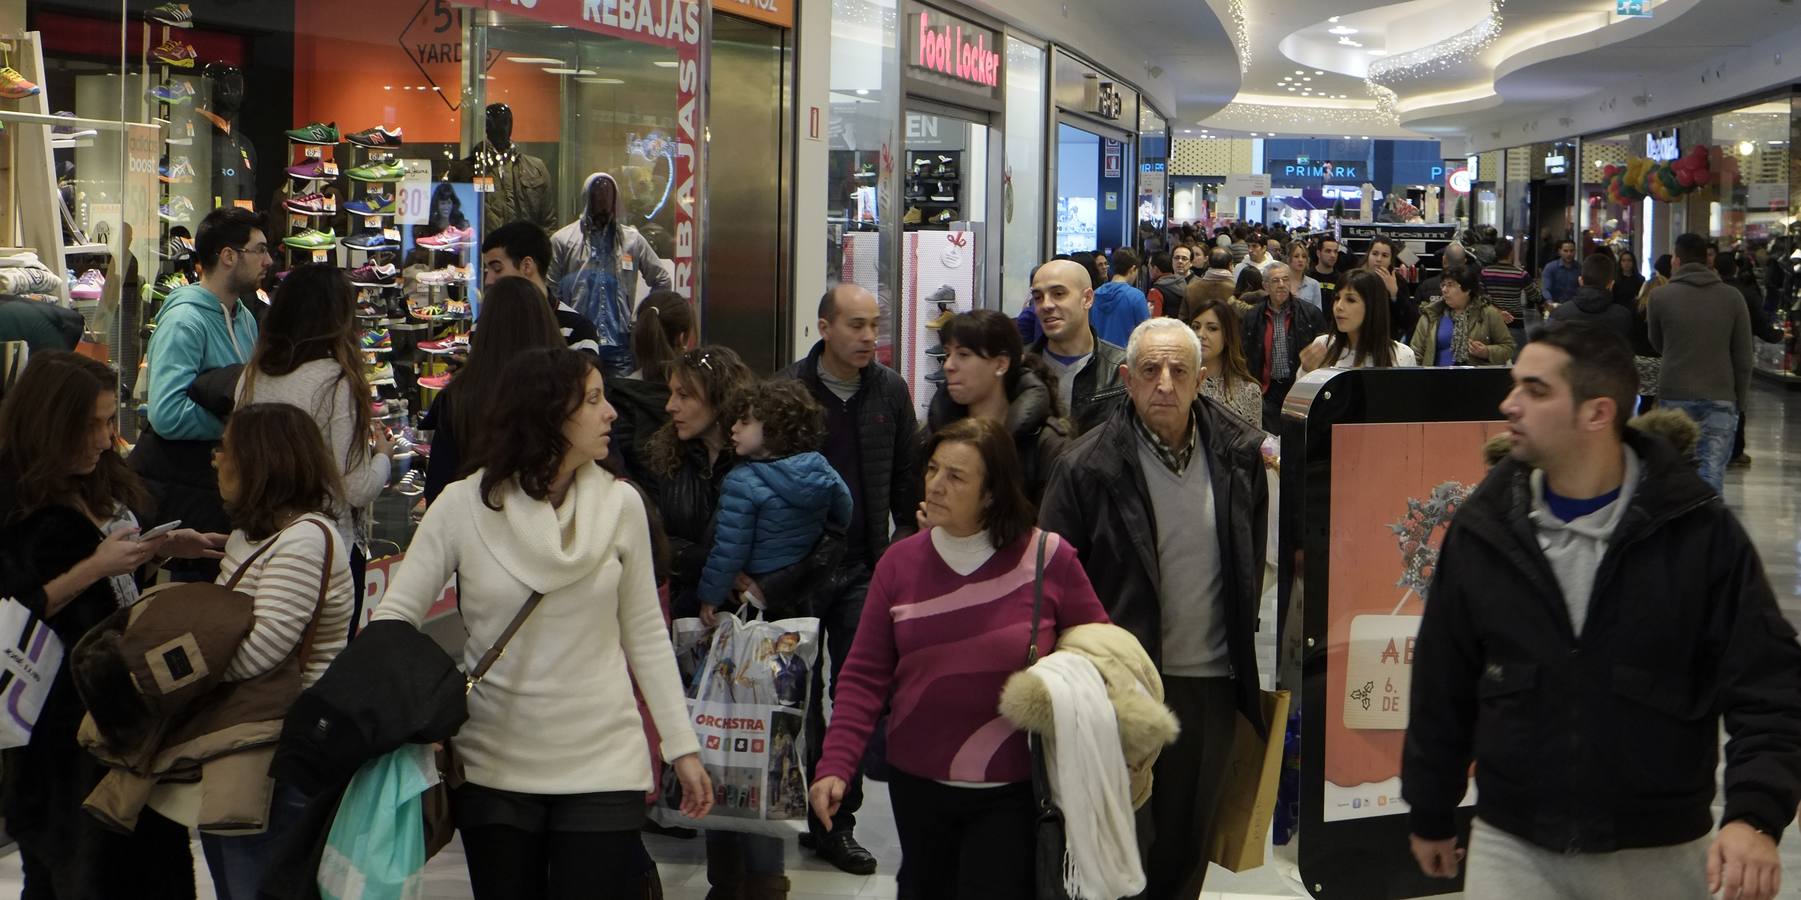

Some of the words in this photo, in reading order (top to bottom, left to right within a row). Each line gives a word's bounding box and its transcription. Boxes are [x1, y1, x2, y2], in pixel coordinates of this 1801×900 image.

[583, 0, 699, 45] REBAJAS
[919, 12, 952, 74] Foot
[956, 25, 999, 87] Locker
[129, 152, 156, 174] boost
[398, 188, 422, 217] 30
[1382, 696, 1400, 711] DE
